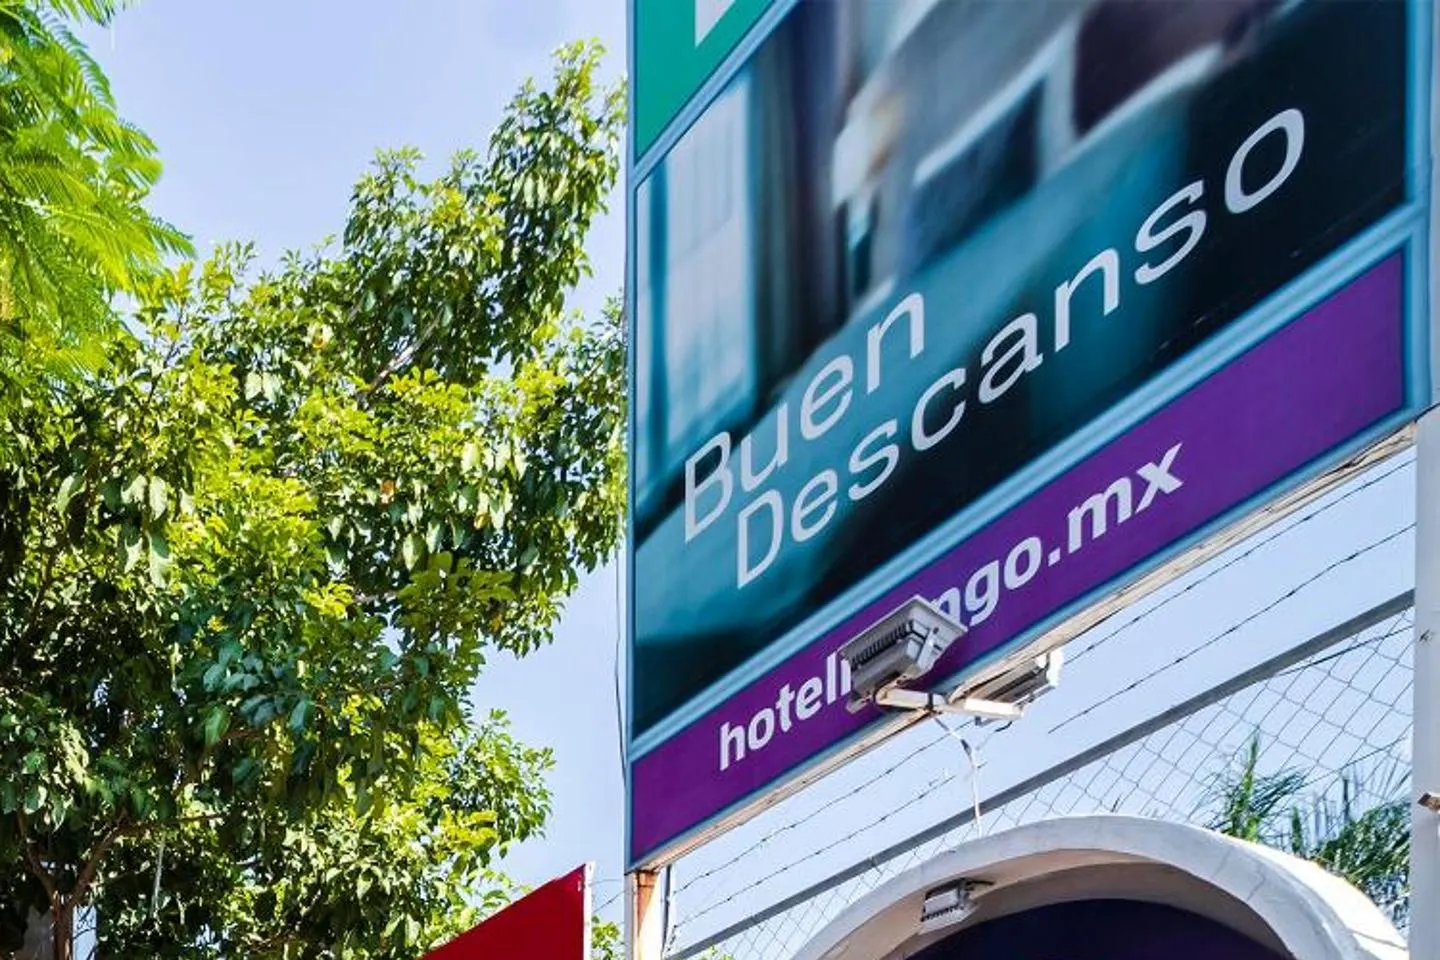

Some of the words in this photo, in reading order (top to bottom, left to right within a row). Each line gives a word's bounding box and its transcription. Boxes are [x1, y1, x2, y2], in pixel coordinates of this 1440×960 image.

[683, 289, 926, 545] Buen
[736, 107, 1306, 589] Descanso
[718, 442, 1186, 772] hotelngo.mx
